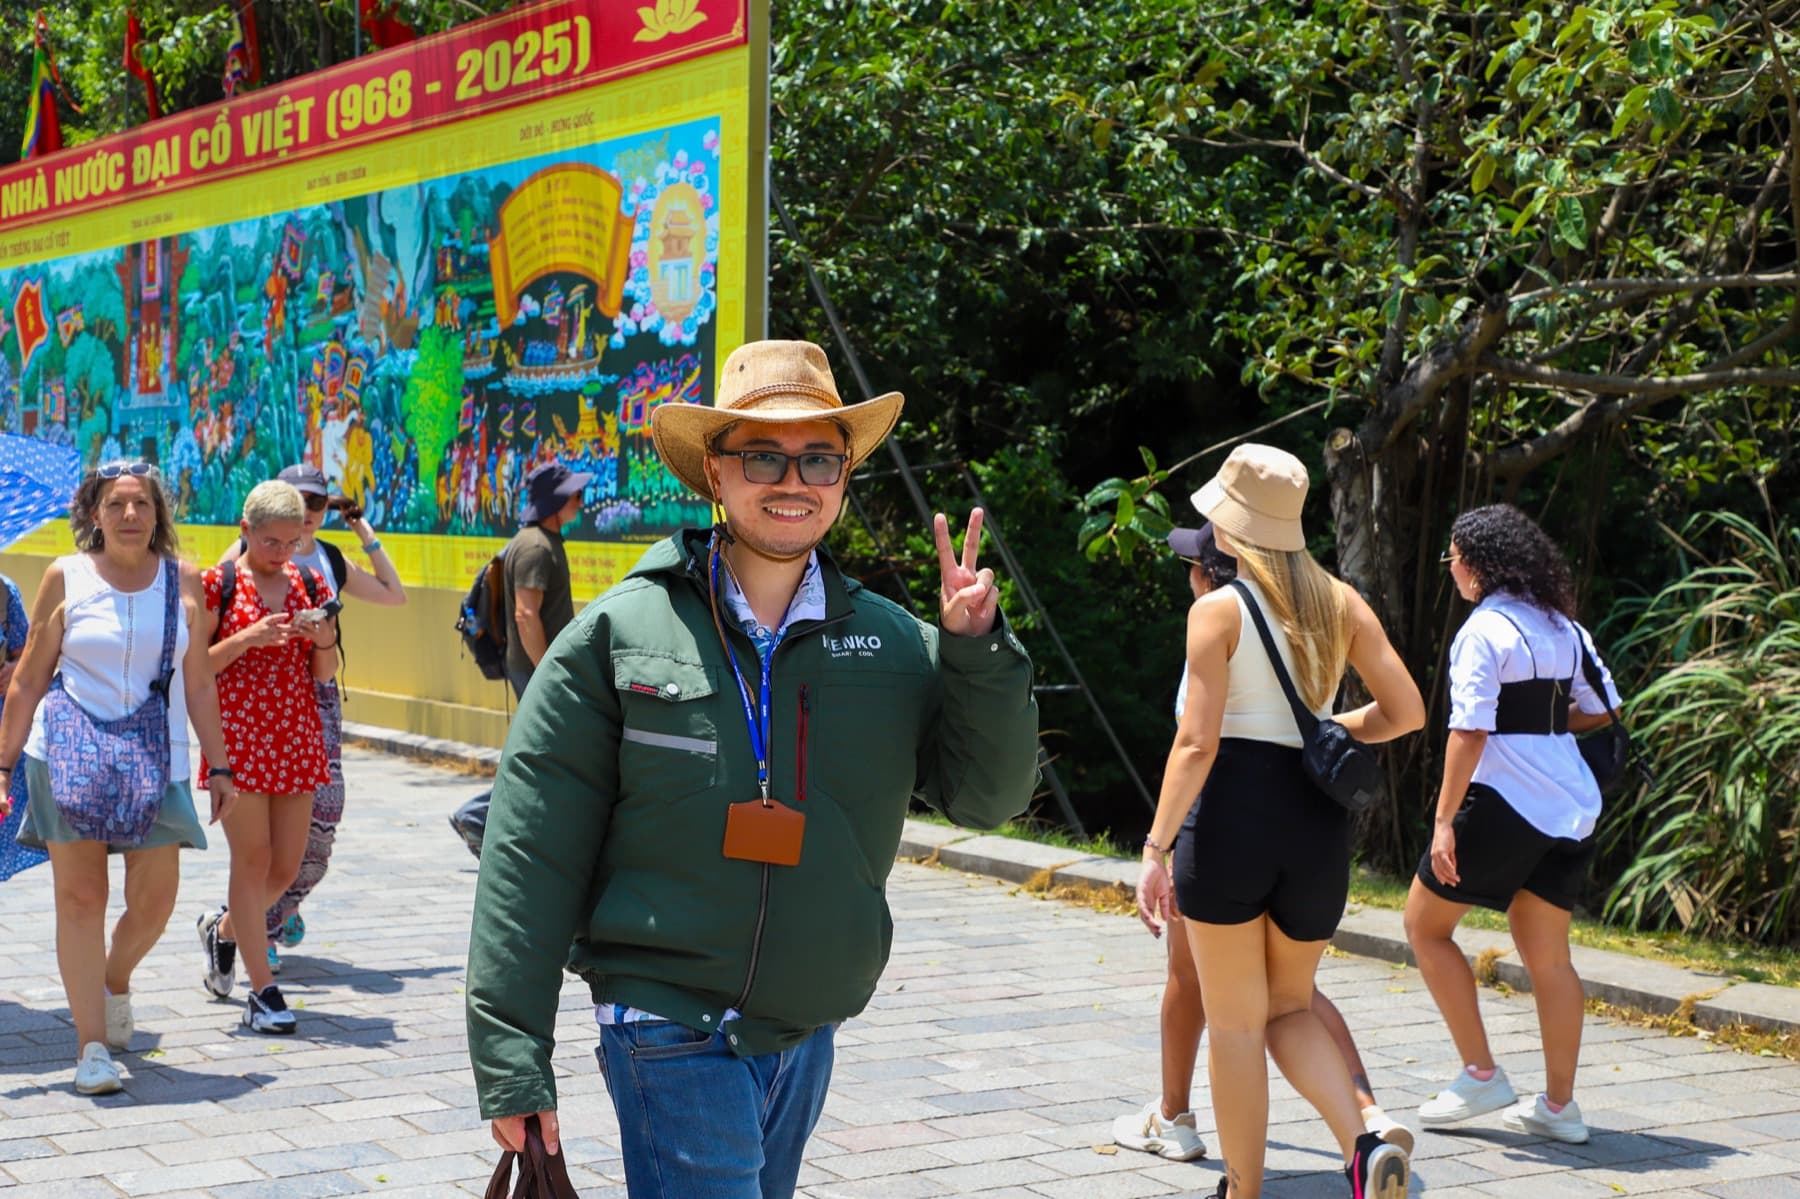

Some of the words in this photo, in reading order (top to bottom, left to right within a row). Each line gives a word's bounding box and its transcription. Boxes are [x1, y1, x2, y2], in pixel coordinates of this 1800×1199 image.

[2, 167, 48, 219] NHÀ
[55, 149, 125, 206] NƯỚC
[132, 135, 181, 188] ĐẠI
[241, 94, 315, 158] VIỆT
[327, 69, 413, 139] (968
[425, 80, 441, 95] -
[455, 15, 592, 102] 2025)
